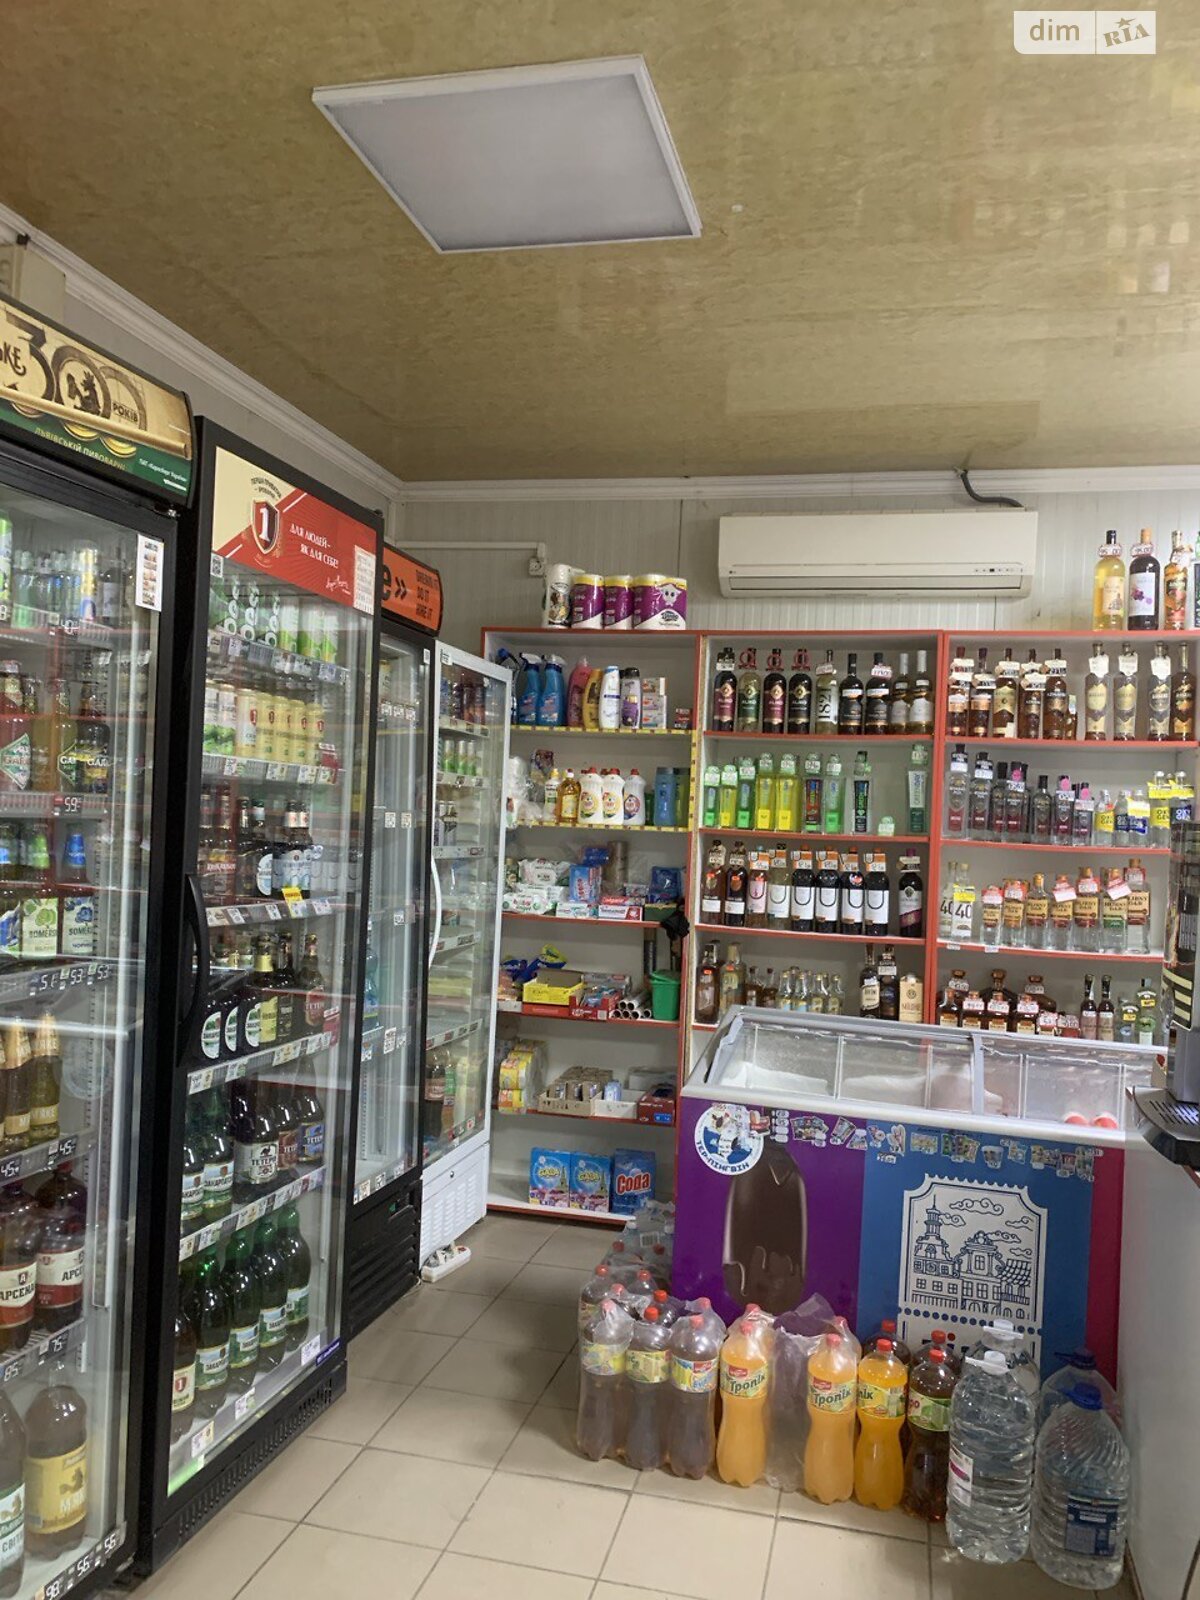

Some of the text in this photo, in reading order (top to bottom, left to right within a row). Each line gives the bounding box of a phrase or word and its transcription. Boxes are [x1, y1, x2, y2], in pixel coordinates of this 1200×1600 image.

[259, 507, 270, 542] 1
[616, 1172, 651, 1195] Сода
[730, 1374, 765, 1394] Тропік
[813, 1389, 851, 1408] Тропік
